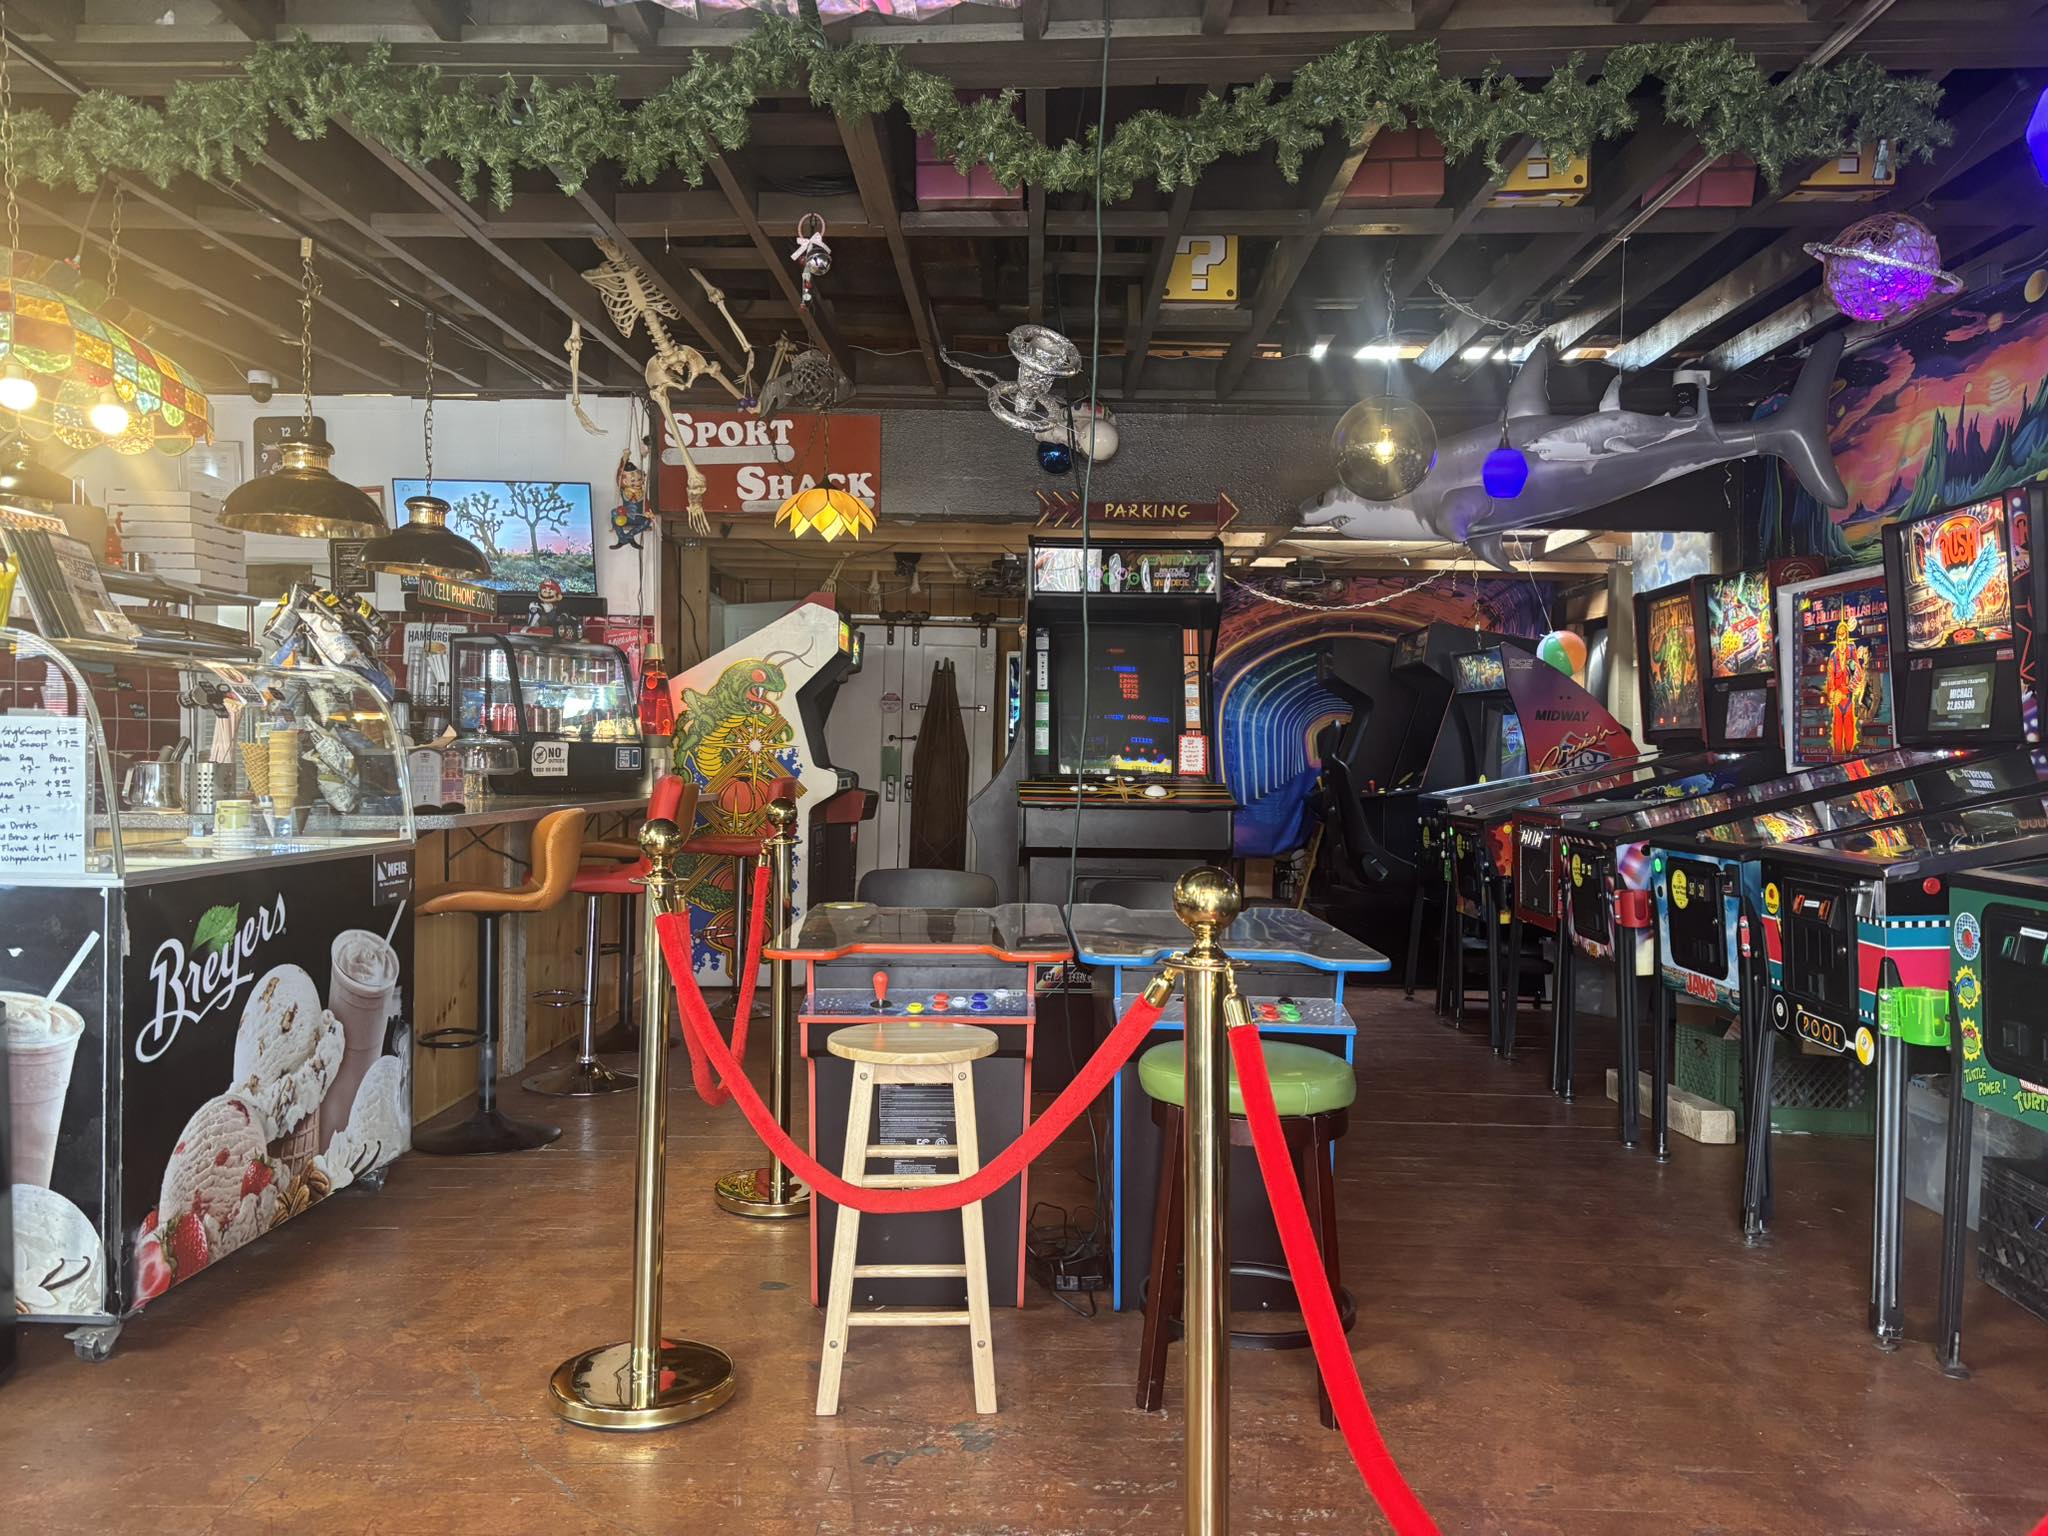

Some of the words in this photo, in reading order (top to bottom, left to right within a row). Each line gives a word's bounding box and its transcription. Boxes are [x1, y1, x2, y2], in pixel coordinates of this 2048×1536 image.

[281, 427, 291, 437] 12
[664, 412, 793, 448] SPORT
[261, 452, 268, 463] 9
[1105, 504, 1191, 519] PARKING
[1939, 525, 1978, 568] RUSH
[420, 579, 433, 597] NO
[433, 582, 451, 601] CELL
[451, 586, 476, 607] PHONE
[476, 591, 495, 611] ZONE
[408, 630, 451, 643] HAMBURG
[1535, 710, 1589, 720] MIDWAY
[548, 747, 561, 758] NO
[10, 821, 39, 831] Drinks
[8, 833, 28, 841] Brew
[135, 892, 285, 1063] Breyers
[1686, 973, 1718, 1002] JAWS
[1963, 1067, 1986, 1083] TURTLE
